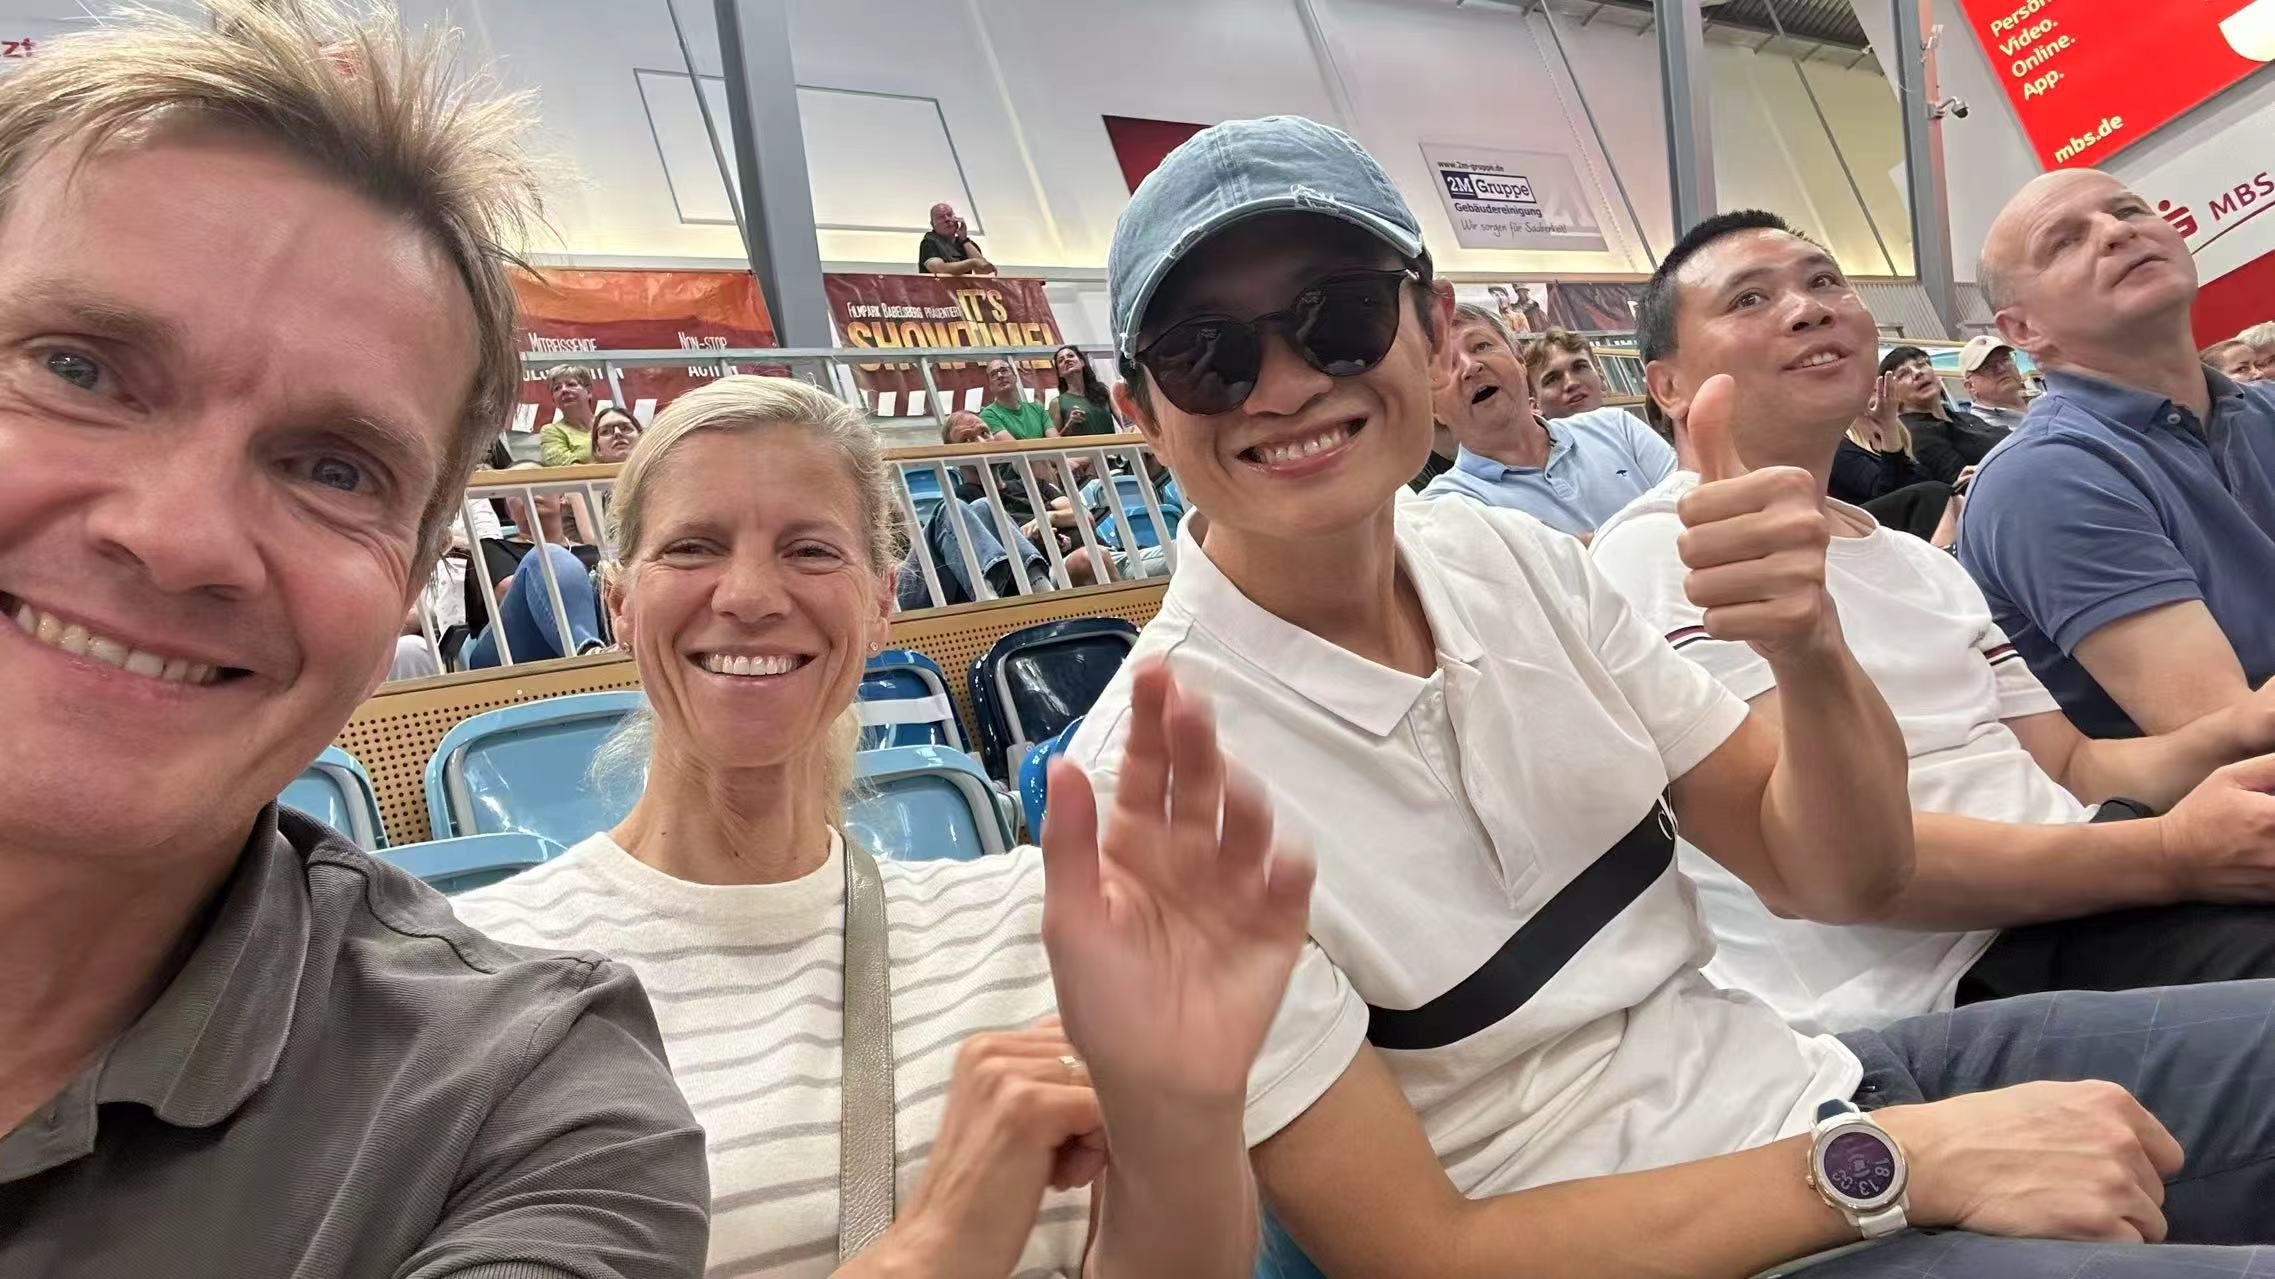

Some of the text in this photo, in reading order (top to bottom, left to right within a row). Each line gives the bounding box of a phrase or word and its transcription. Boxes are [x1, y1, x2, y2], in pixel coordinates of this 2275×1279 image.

[1999, 19, 2059, 56] Video.
[2011, 35, 2076, 78] Online.
[2023, 70, 2064, 101] App.
[2055, 115, 2124, 164] mbs.de
[1447, 176, 1530, 198] 2M Gruppe
[2208, 172, 2274, 221] MBS
[1454, 202, 1543, 218] Gebäudereinigung
[1460, 219, 1478, 231] Wir
[1509, 221, 1522, 238] für
[956, 289, 1008, 322] IT'S
